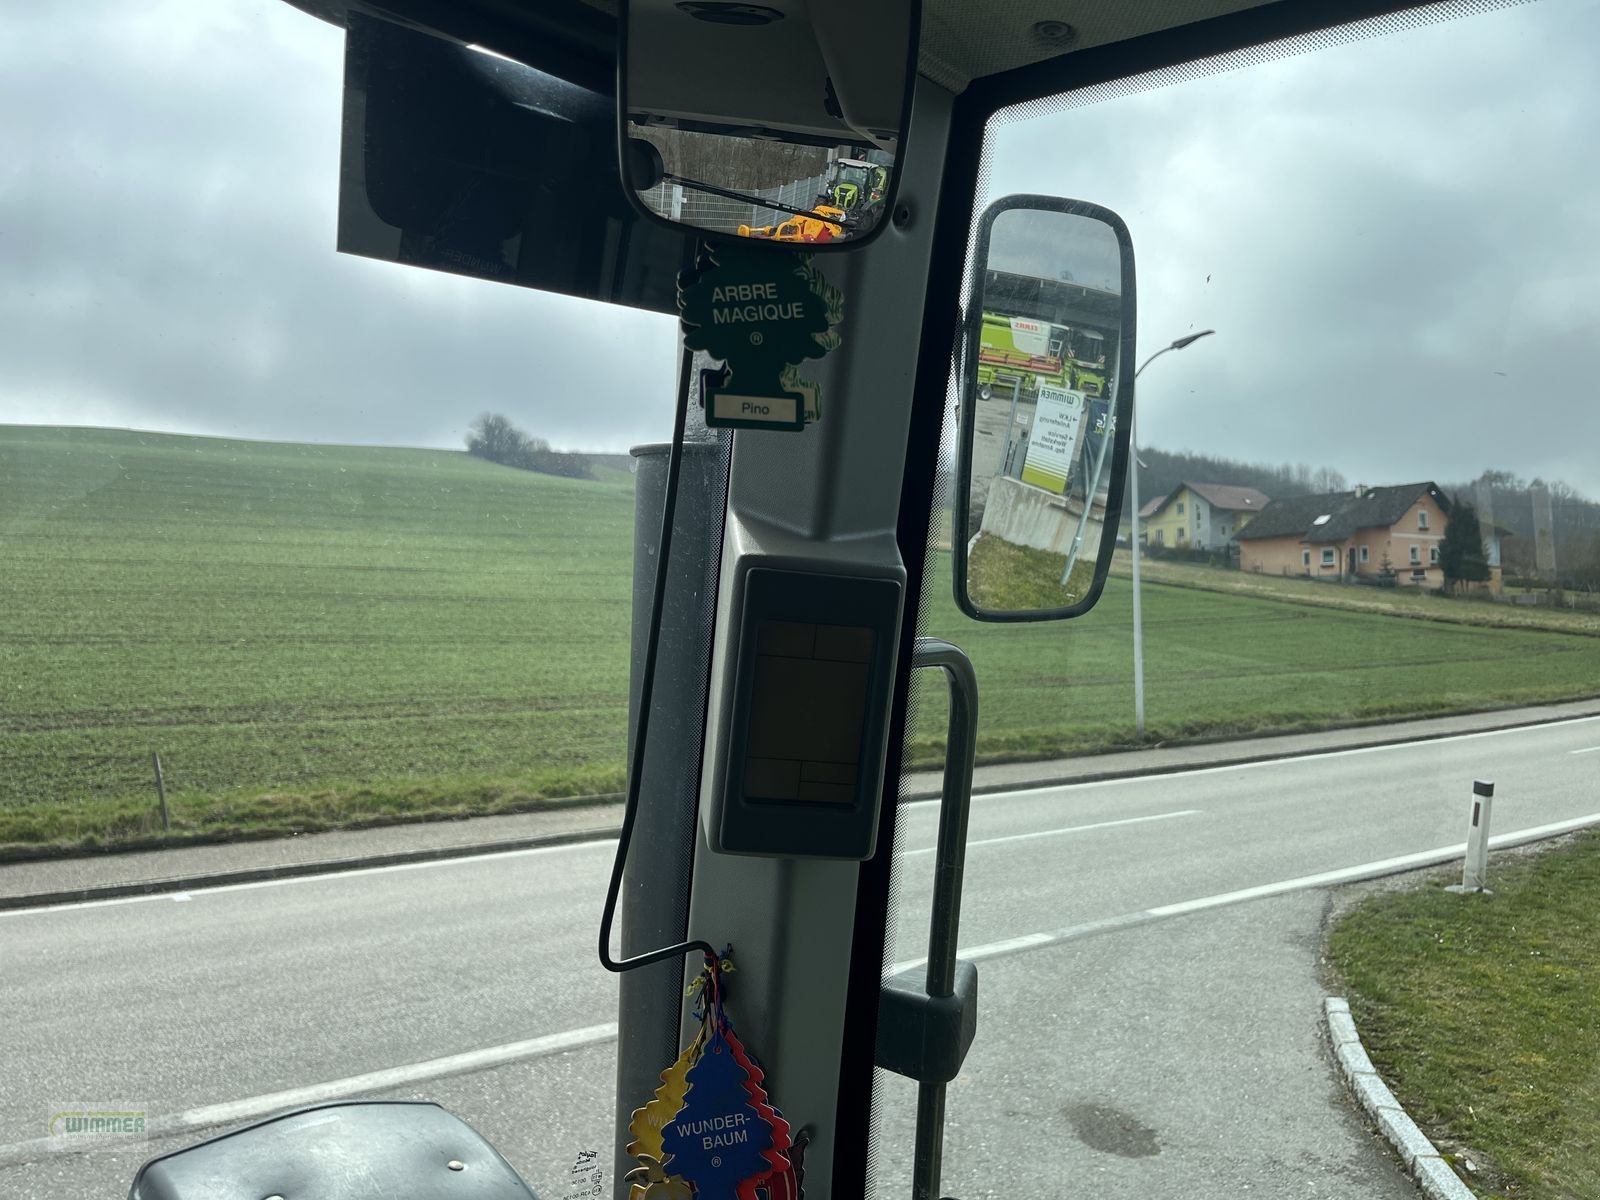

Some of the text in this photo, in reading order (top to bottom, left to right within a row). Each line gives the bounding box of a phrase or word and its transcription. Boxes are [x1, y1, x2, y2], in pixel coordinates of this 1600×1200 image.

[711, 283, 778, 303] ARBRE
[713, 302, 805, 324] MAGIQUE
[742, 402, 770, 416] Pino
[677, 1113, 751, 1138] WUNDER-
[702, 1129, 748, 1150] BAUM
